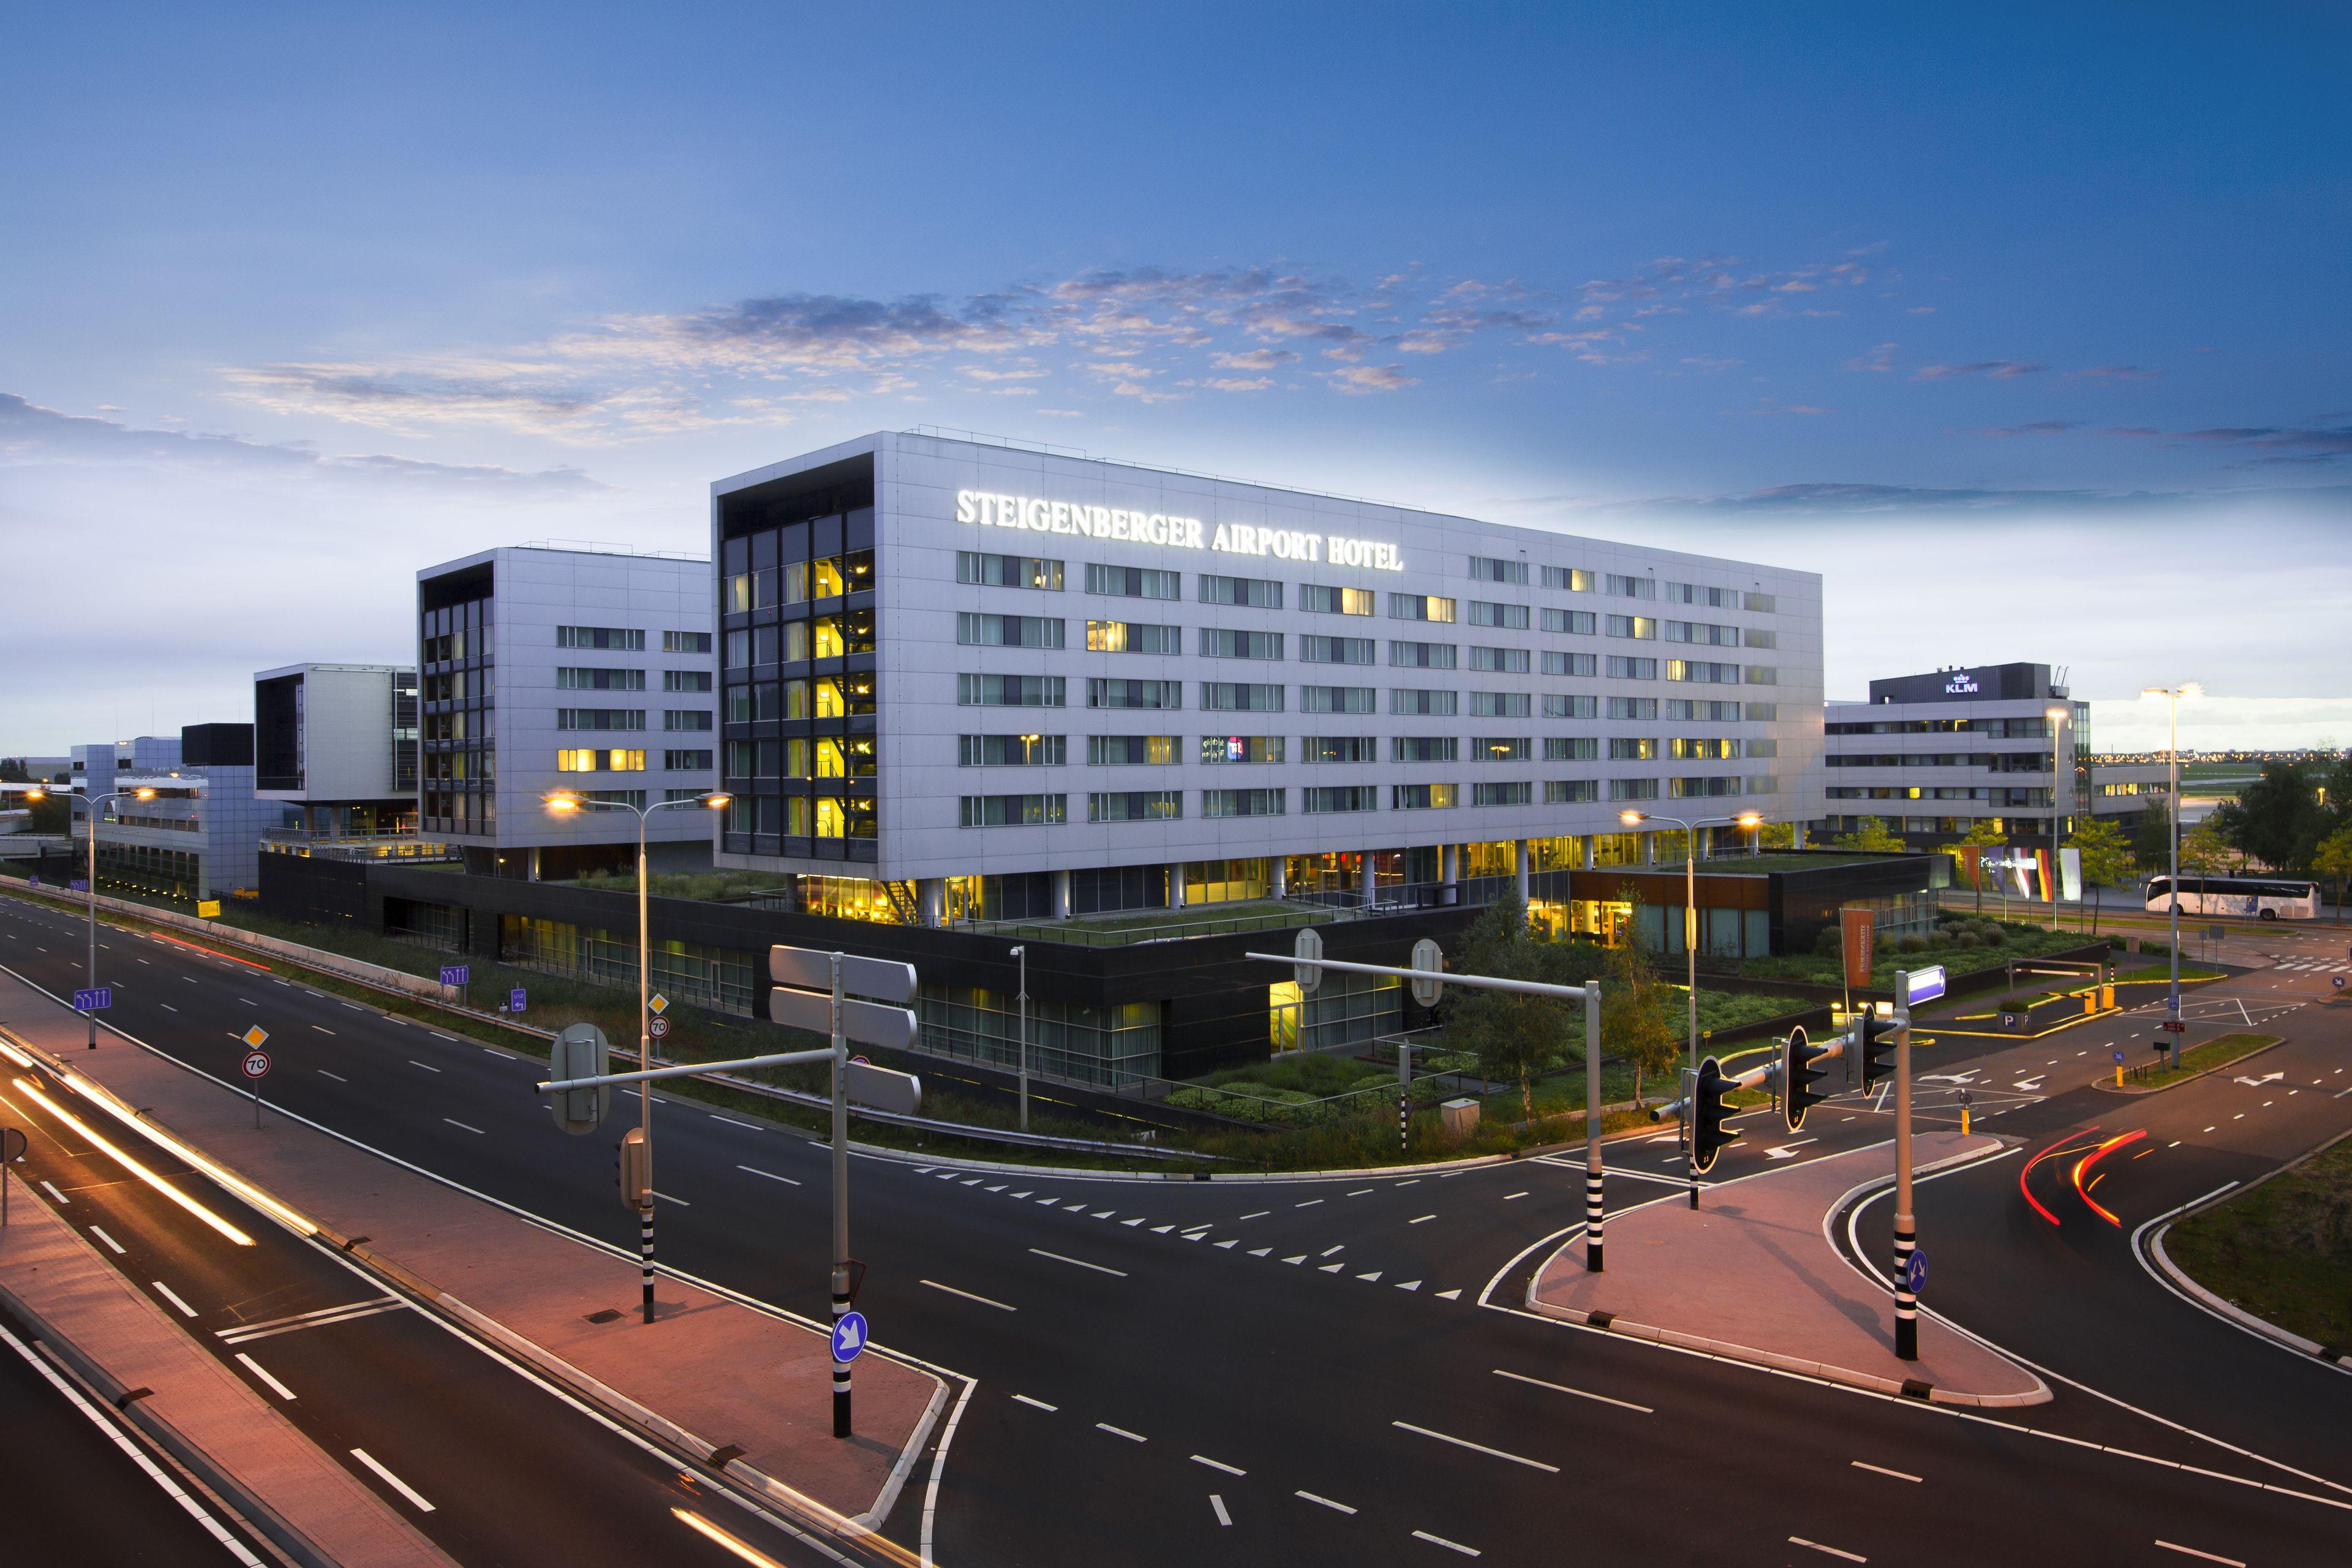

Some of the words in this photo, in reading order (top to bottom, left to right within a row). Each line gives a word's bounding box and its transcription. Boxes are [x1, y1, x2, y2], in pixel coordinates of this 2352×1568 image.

[956, 489, 1204, 549] STEIGENBERGER
[1210, 522, 1321, 562] AIRPORT
[1327, 537, 1404, 571] HOTEL
[1946, 683, 1978, 693] KLM
[2005, 1015, 2014, 1026] P
[2024, 1015, 2029, 1026] P
[652, 1023, 666, 1031] 70
[247, 1059, 265, 1071] 70
